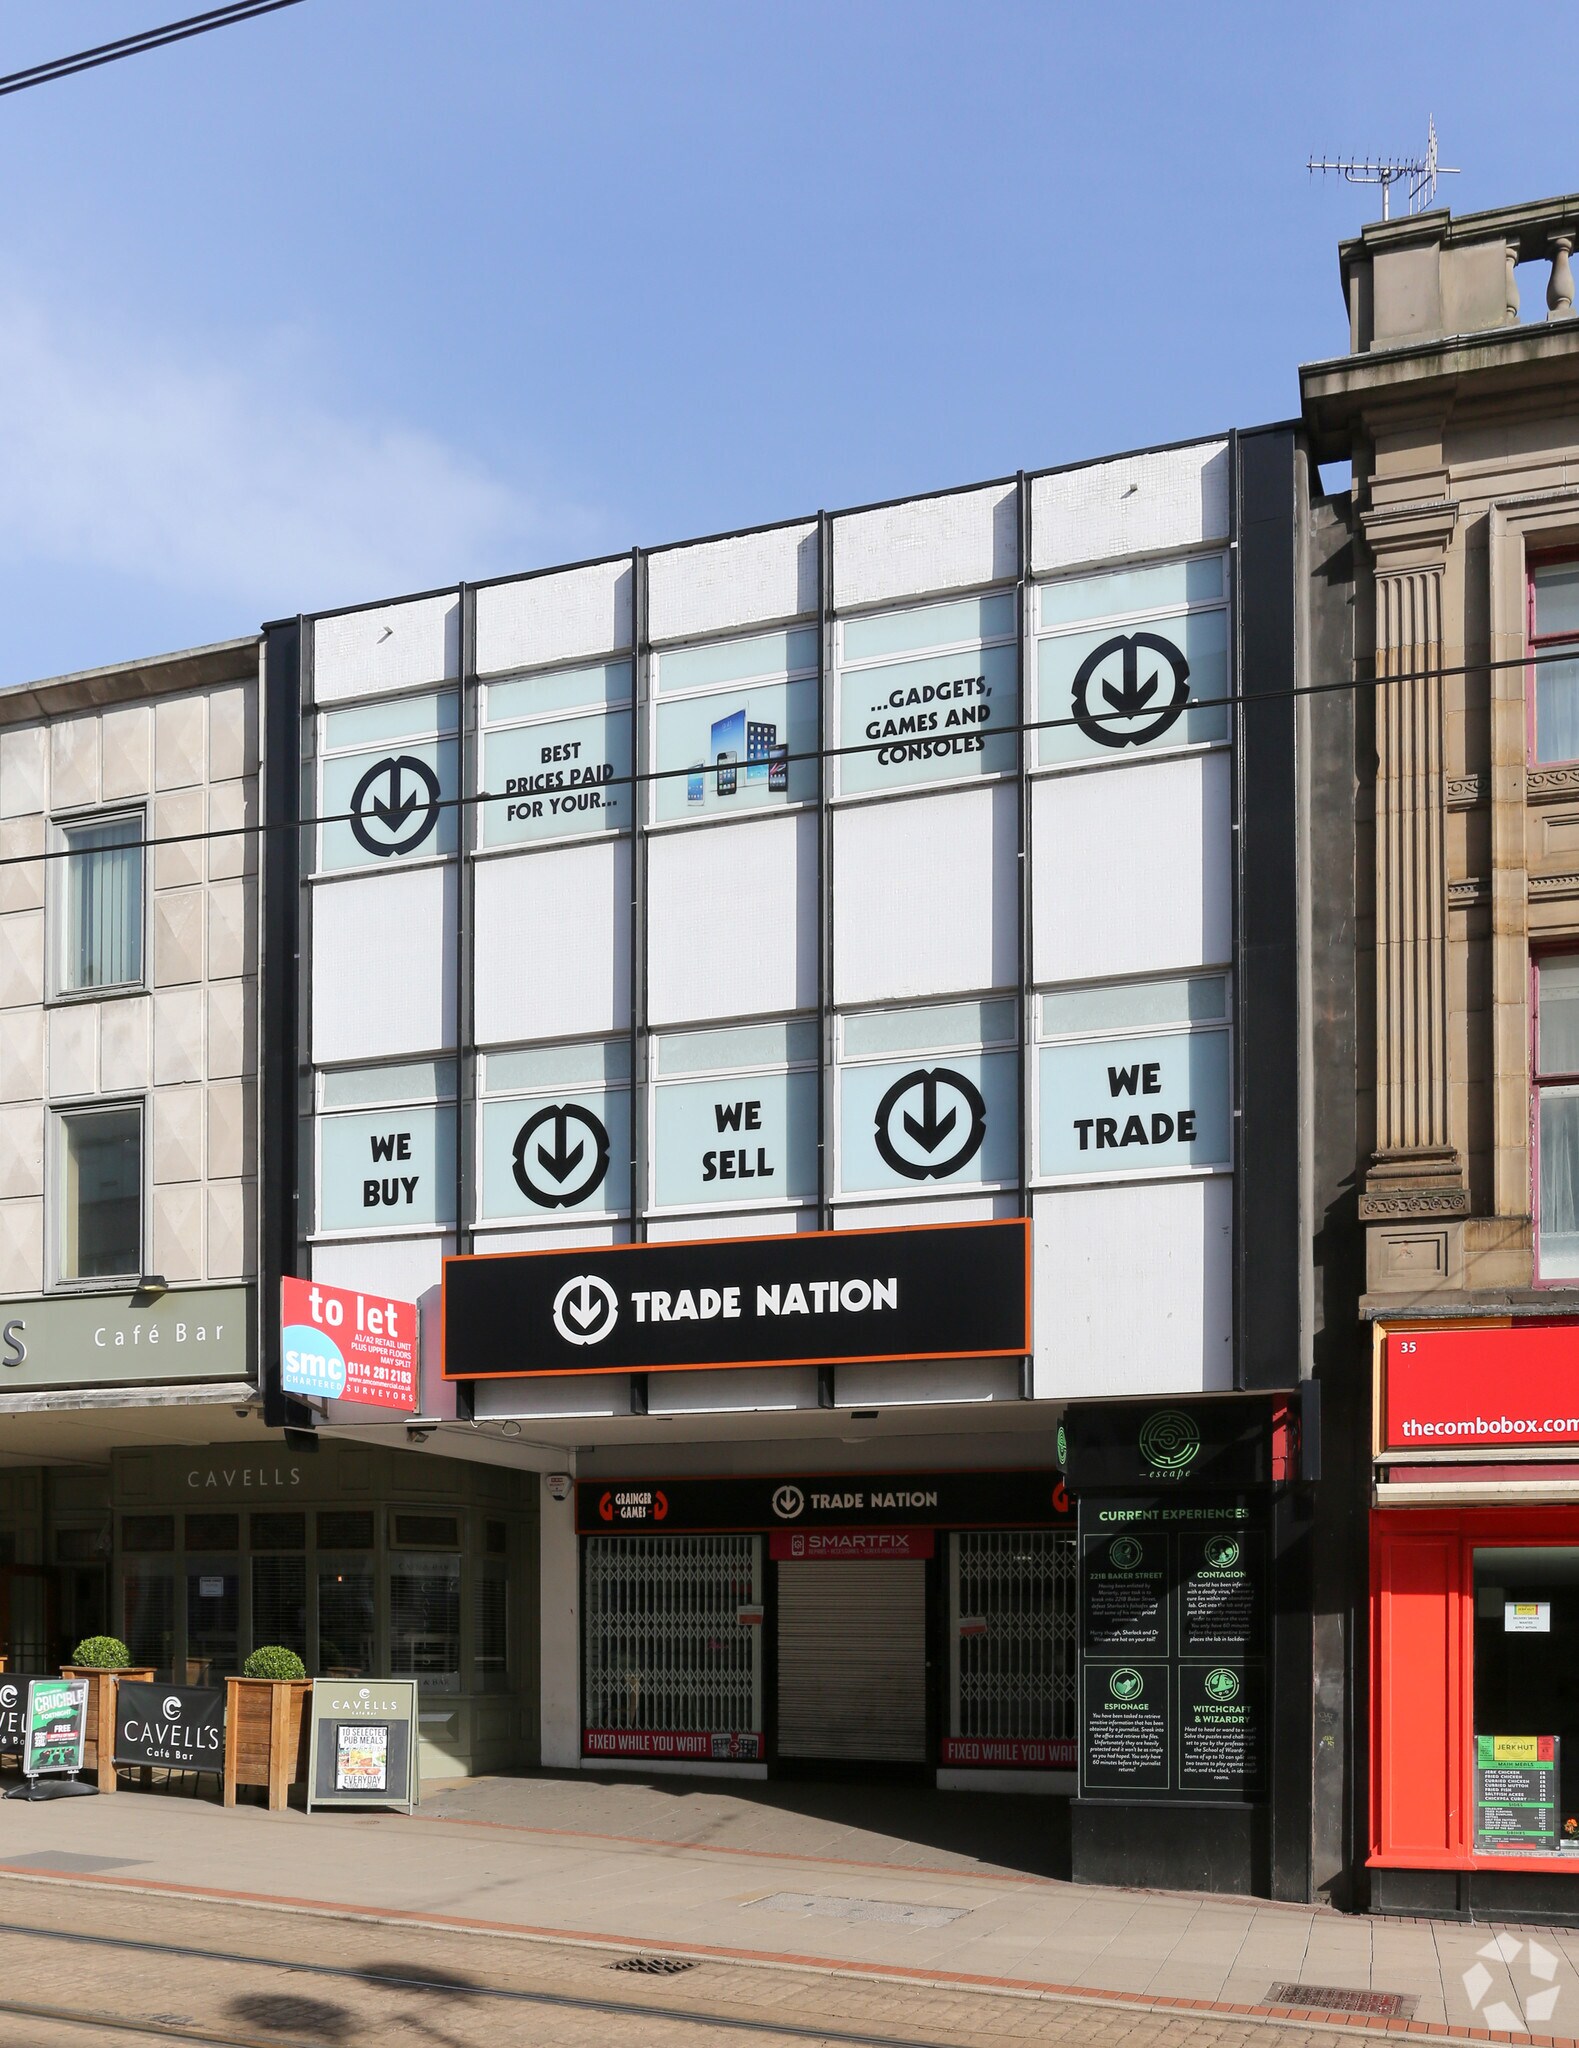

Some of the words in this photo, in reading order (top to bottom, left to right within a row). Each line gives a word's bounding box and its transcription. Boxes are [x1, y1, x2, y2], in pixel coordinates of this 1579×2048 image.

[866, 712, 937, 739] GAMES
[945, 704, 991, 729] AND
[540, 741, 581, 765] BEST
[877, 735, 985, 766] CONSOLES
[506, 770, 564, 795] PRICES
[570, 762, 614, 787] PAID
[507, 802, 543, 821] FOR
[548, 792, 618, 815] YOUR...
[1108, 1062, 1160, 1098] WE
[715, 1100, 761, 1133] WE
[1073, 1109, 1197, 1151] TRADE
[370, 1131, 412, 1164] WE
[702, 1147, 774, 1183] SELL
[362, 1175, 419, 1208] BUY
[630, 1285, 742, 1324] TRADE
[755, 1277, 898, 1317] NATION
[309, 1286, 343, 1326] to
[357, 1296, 398, 1337] let
[94, 1324, 159, 1347] Café
[176, 1323, 223, 1342] Bar
[355, 1334, 374, 1344] A1/A2
[375, 1338, 396, 1348] RETAIL
[397, 1342, 411, 1351] UNIT
[351, 1343, 367, 1351] PLUS
[368, 1345, 388, 1356] UPPER
[389, 1349, 411, 1359] FLOORS
[1400, 1342, 1416, 1353] 35
[286, 1350, 342, 1380] smc
[381, 1357, 394, 1366] MAY
[394, 1359, 411, 1368] SPLIT
[348, 1362, 370, 1377] 0114
[374, 1366, 389, 1381] 281
[391, 1368, 412, 1384] 2183
[286, 1375, 342, 1390] CHARTERED
[346, 1385, 414, 1402] SURVEYORS
[1402, 1416, 1579, 1437] thecombobox.com
[188, 1468, 300, 1488] CAVELLS
[1149, 1469, 1191, 1480] escape
[615, 1492, 652, 1504] GRAINGER
[811, 1493, 864, 1509] TRADE
[871, 1491, 938, 1508] NATION
[621, 1506, 646, 1518] GAMES
[1099, 1510, 1159, 1521] CURRENT
[1163, 1508, 1249, 1519] EXPERIENCES
[809, 1535, 909, 1547] SMARTFIX
[35, 1689, 84, 1712] CRUCIBLE
[332, 1701, 397, 1709] CAVELLS
[1193, 1705, 1251, 1713] WITCHCRAFT
[54, 1724, 71, 1733] FREE
[352, 1728, 387, 1736] SELECTED
[344, 1736, 358, 1744] PUB
[359, 1736, 384, 1744] MEALS
[588, 1734, 616, 1751] FIXED
[618, 1735, 650, 1752] WHILE
[652, 1736, 674, 1752] YOU
[676, 1736, 707, 1753] WAIT!
[146, 1747, 170, 1759] Café
[176, 1751, 194, 1761] Bar
[948, 1743, 979, 1760] FIXED
[982, 1744, 1018, 1760] WHILE
[1021, 1745, 1045, 1760] YOU
[344, 1776, 381, 1784] EVERYDAY
